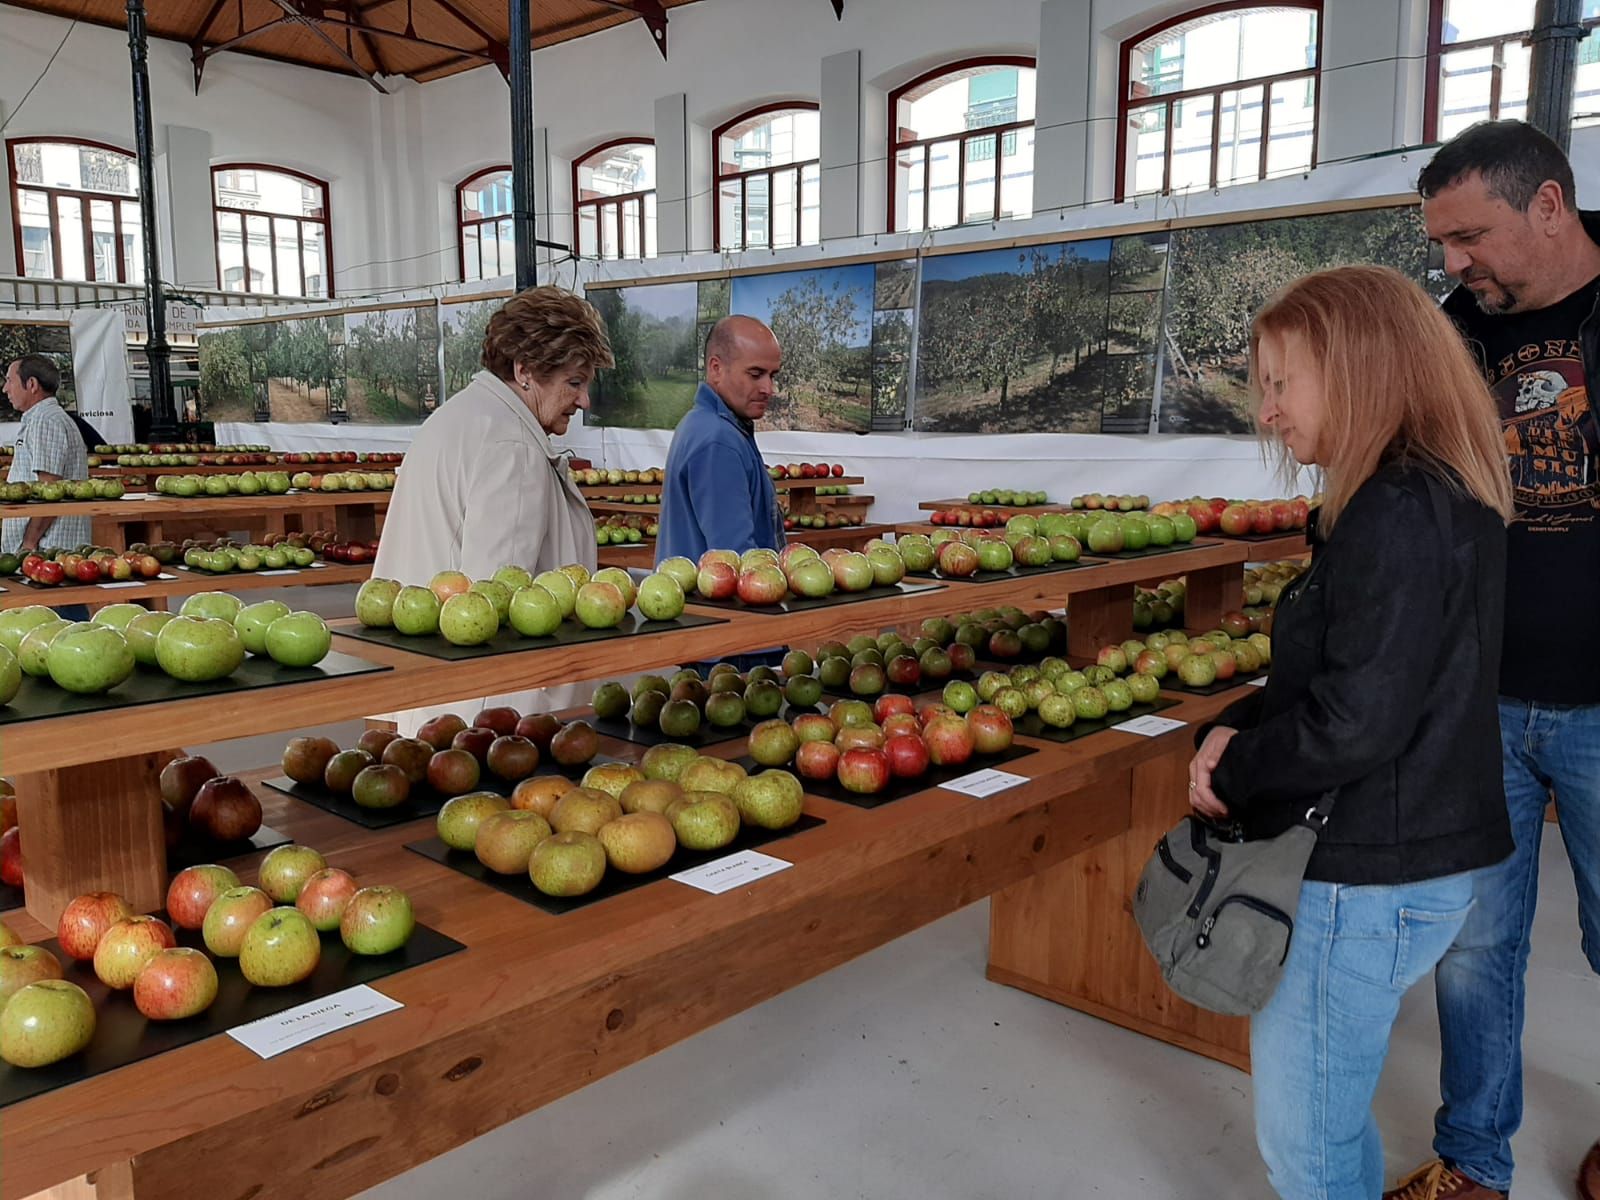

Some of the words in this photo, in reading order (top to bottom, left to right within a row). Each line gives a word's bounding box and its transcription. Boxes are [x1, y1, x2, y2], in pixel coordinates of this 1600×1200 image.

[124, 303, 146, 316] RIN
[172, 306, 187, 319] DE
[125, 319, 141, 328] DA
[166, 321, 195, 331] MPLE
